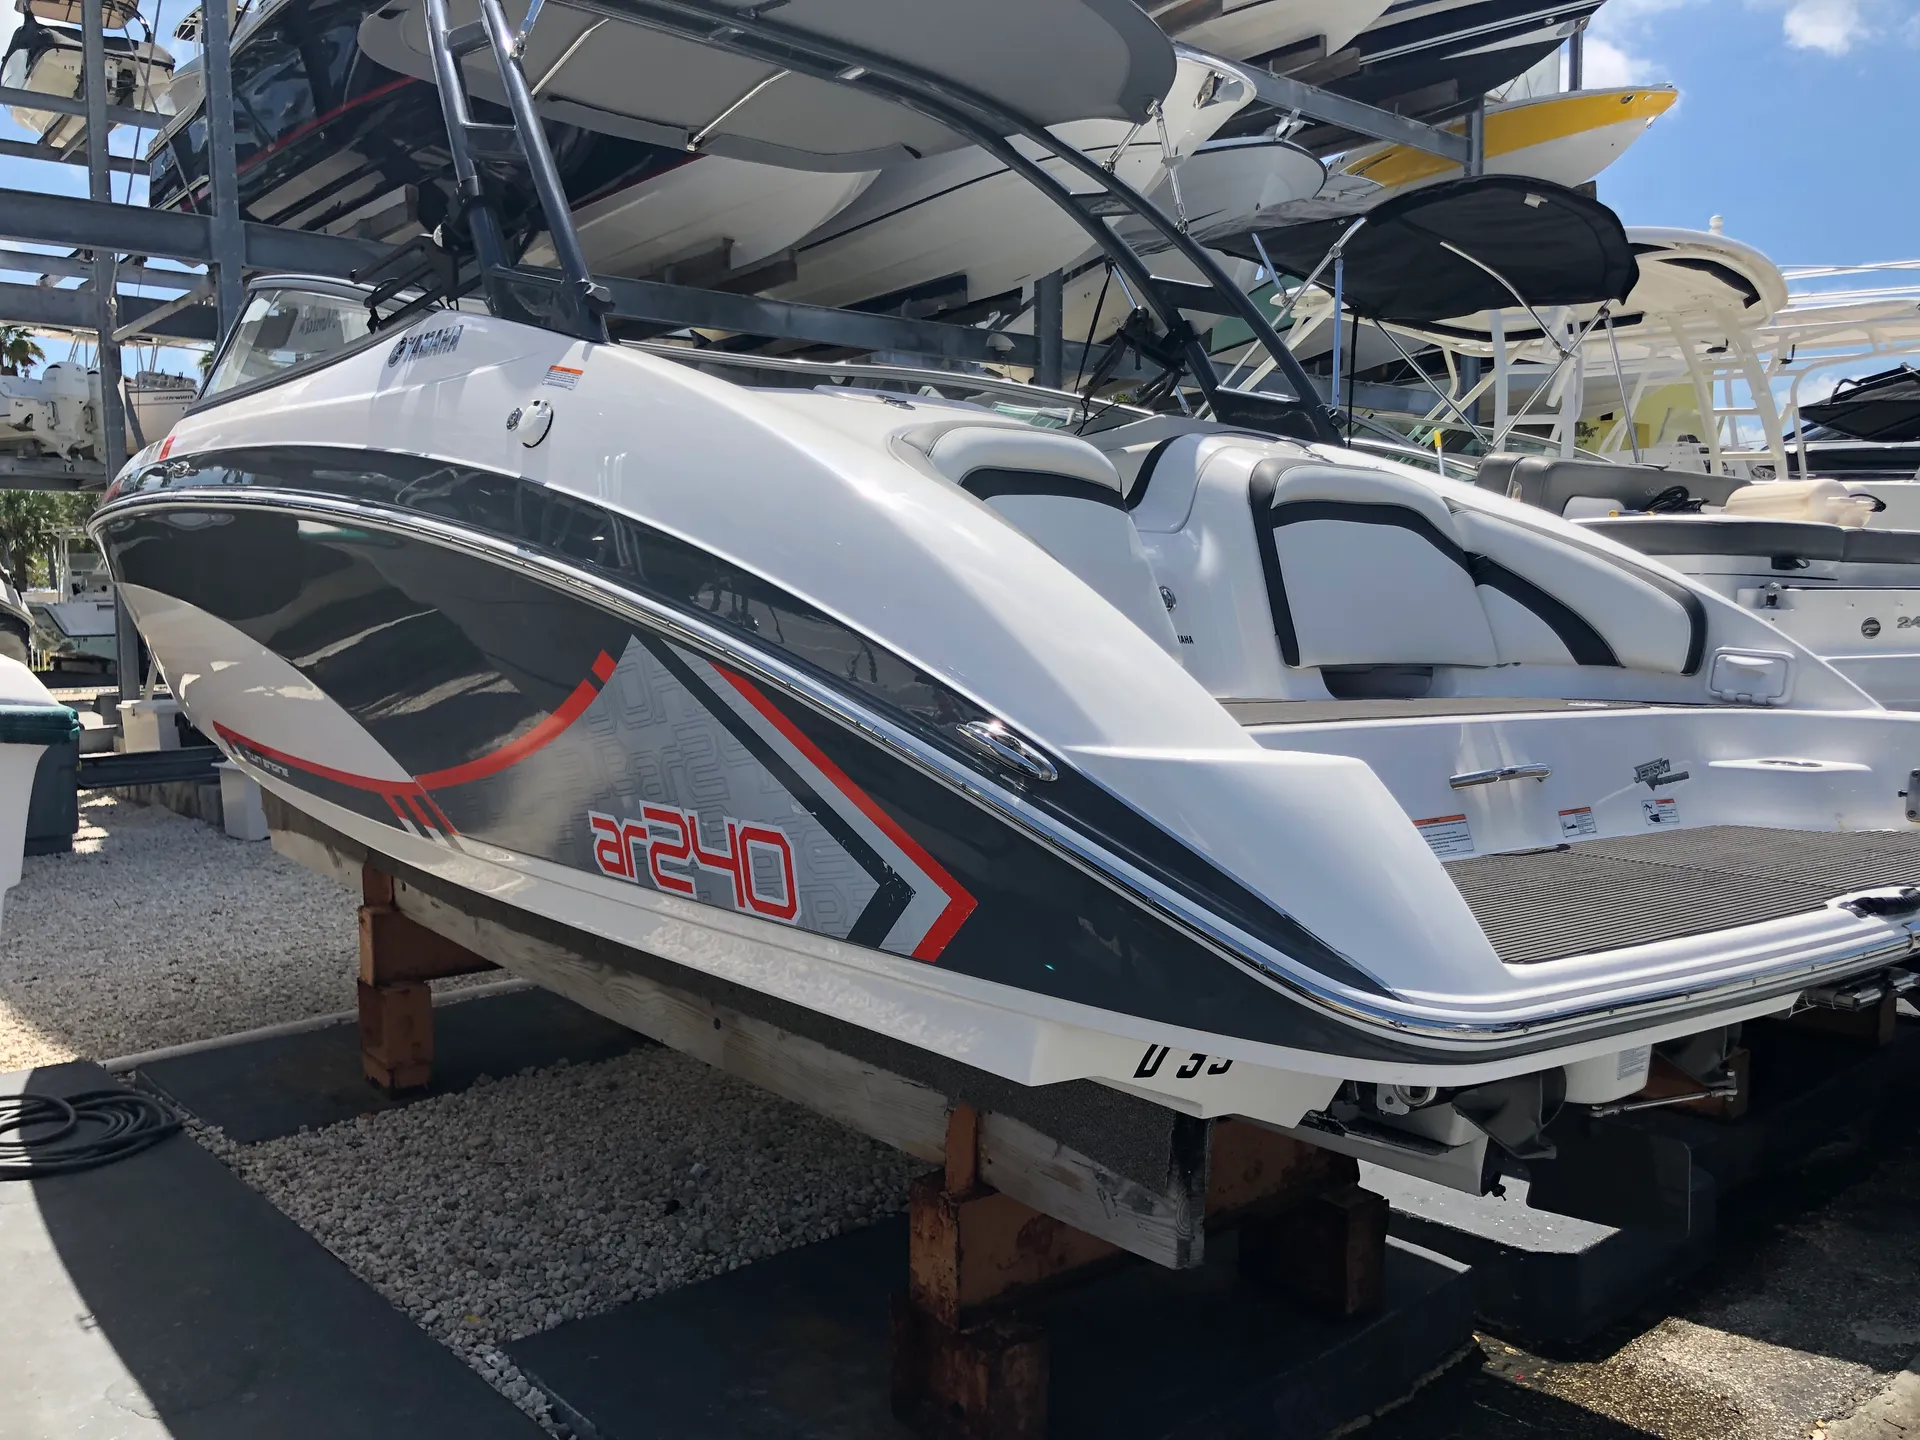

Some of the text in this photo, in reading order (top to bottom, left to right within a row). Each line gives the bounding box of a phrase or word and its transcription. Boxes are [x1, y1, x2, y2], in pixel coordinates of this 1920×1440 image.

[403, 324, 465, 363] YAMAHA
[63, 464, 76, 473] 14
[1177, 635, 1194, 645] AHA
[589, 802, 800, 922] ar240
